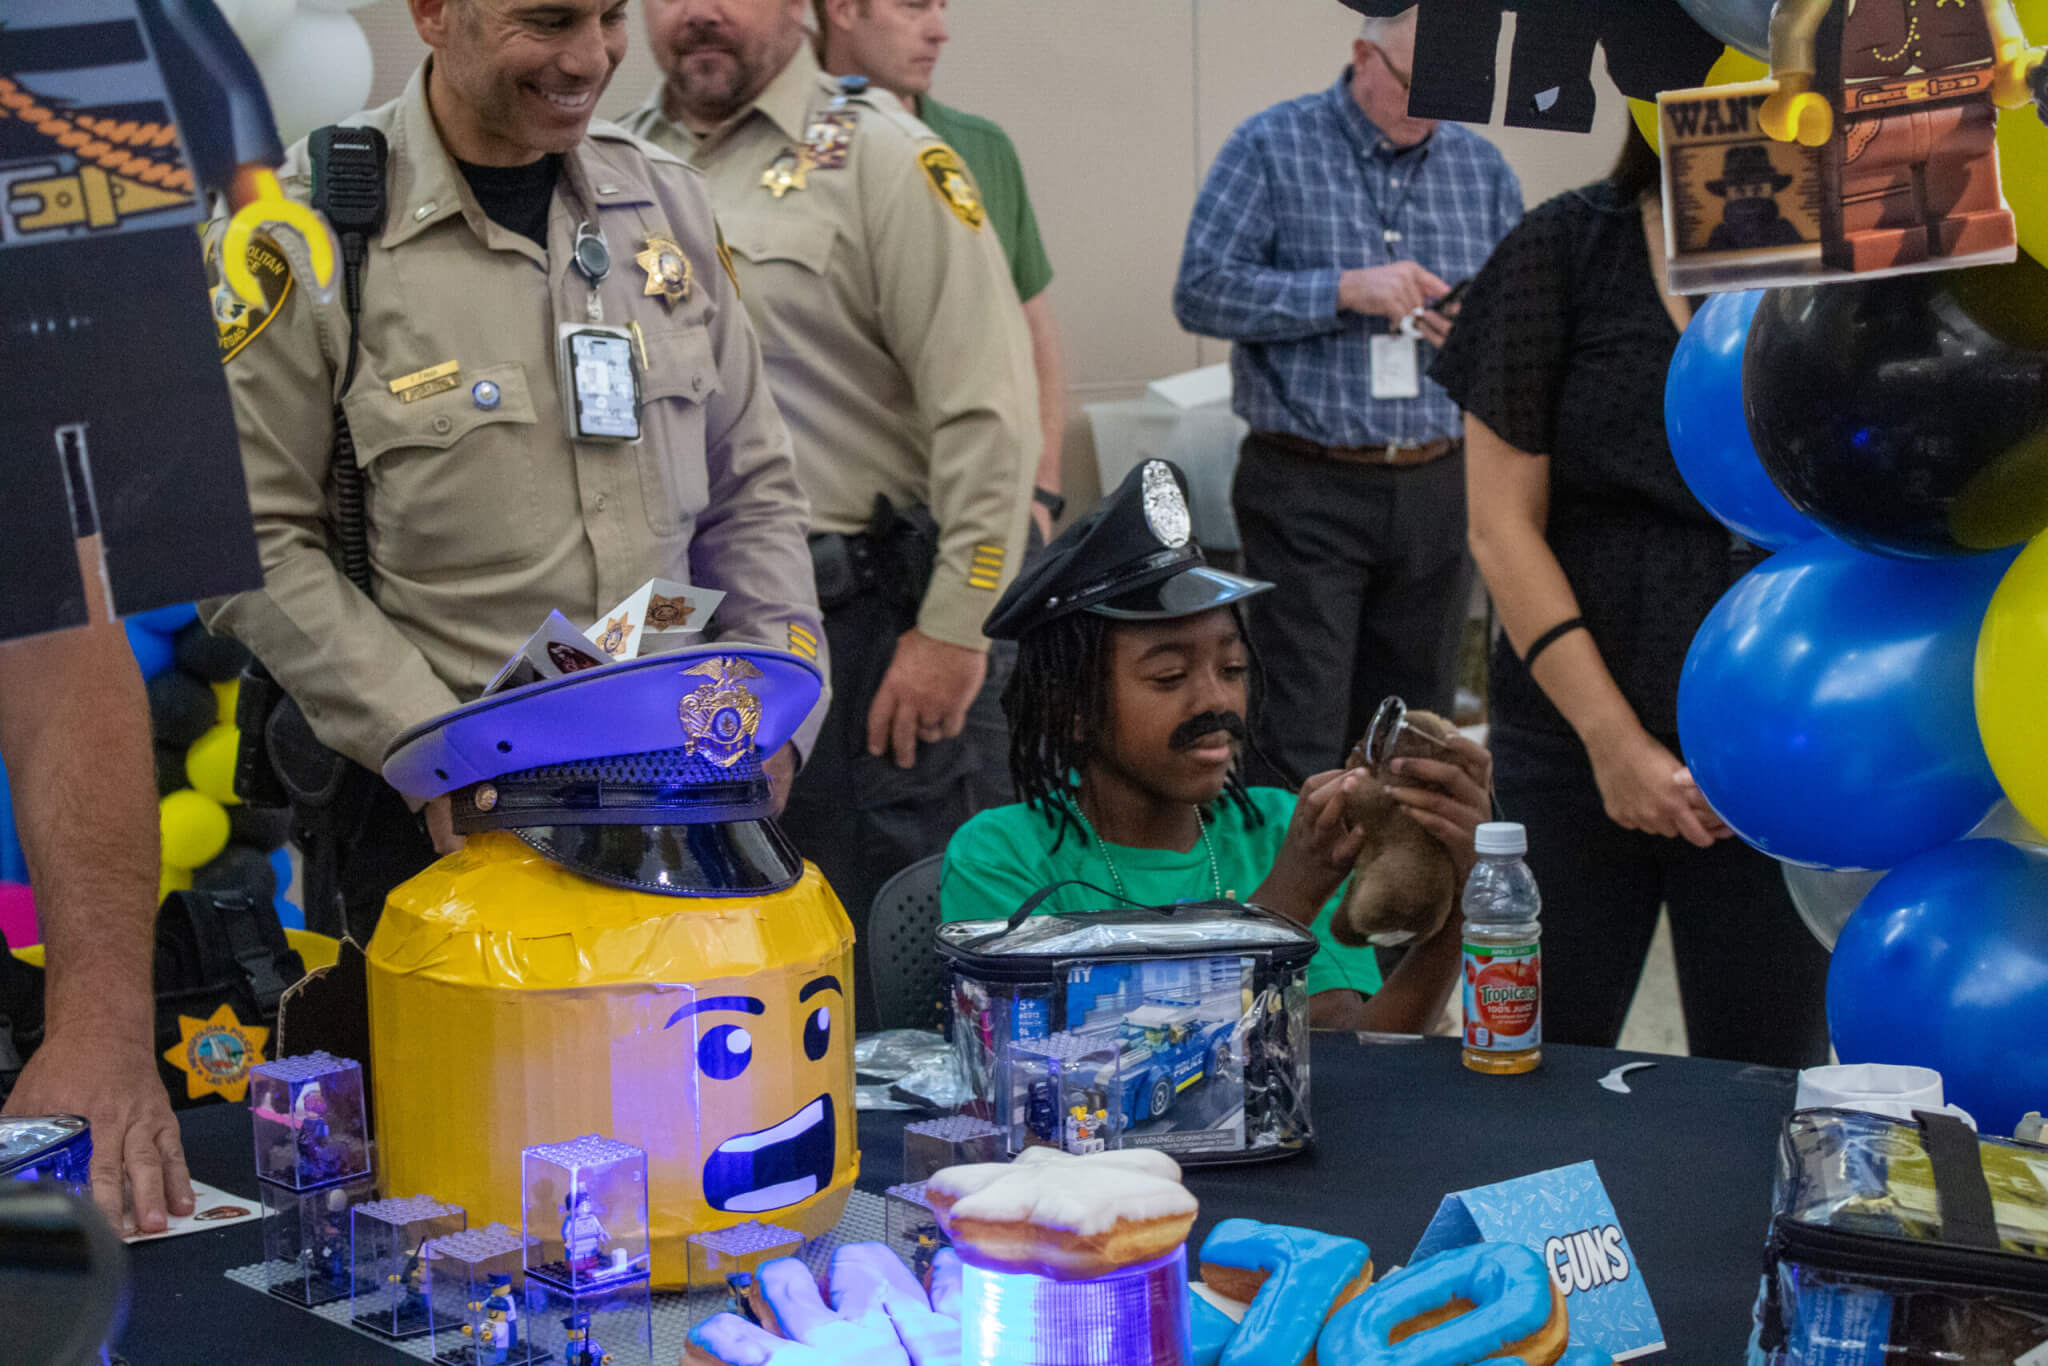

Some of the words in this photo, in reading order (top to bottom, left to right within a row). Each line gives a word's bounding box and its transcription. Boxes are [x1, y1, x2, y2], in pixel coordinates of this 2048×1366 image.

[1665, 95, 1769, 137] WAN
[1066, 966, 1093, 984] ITY
[1480, 985, 1537, 1005] Tropicana
[1543, 1223, 1630, 1297] GUNS
